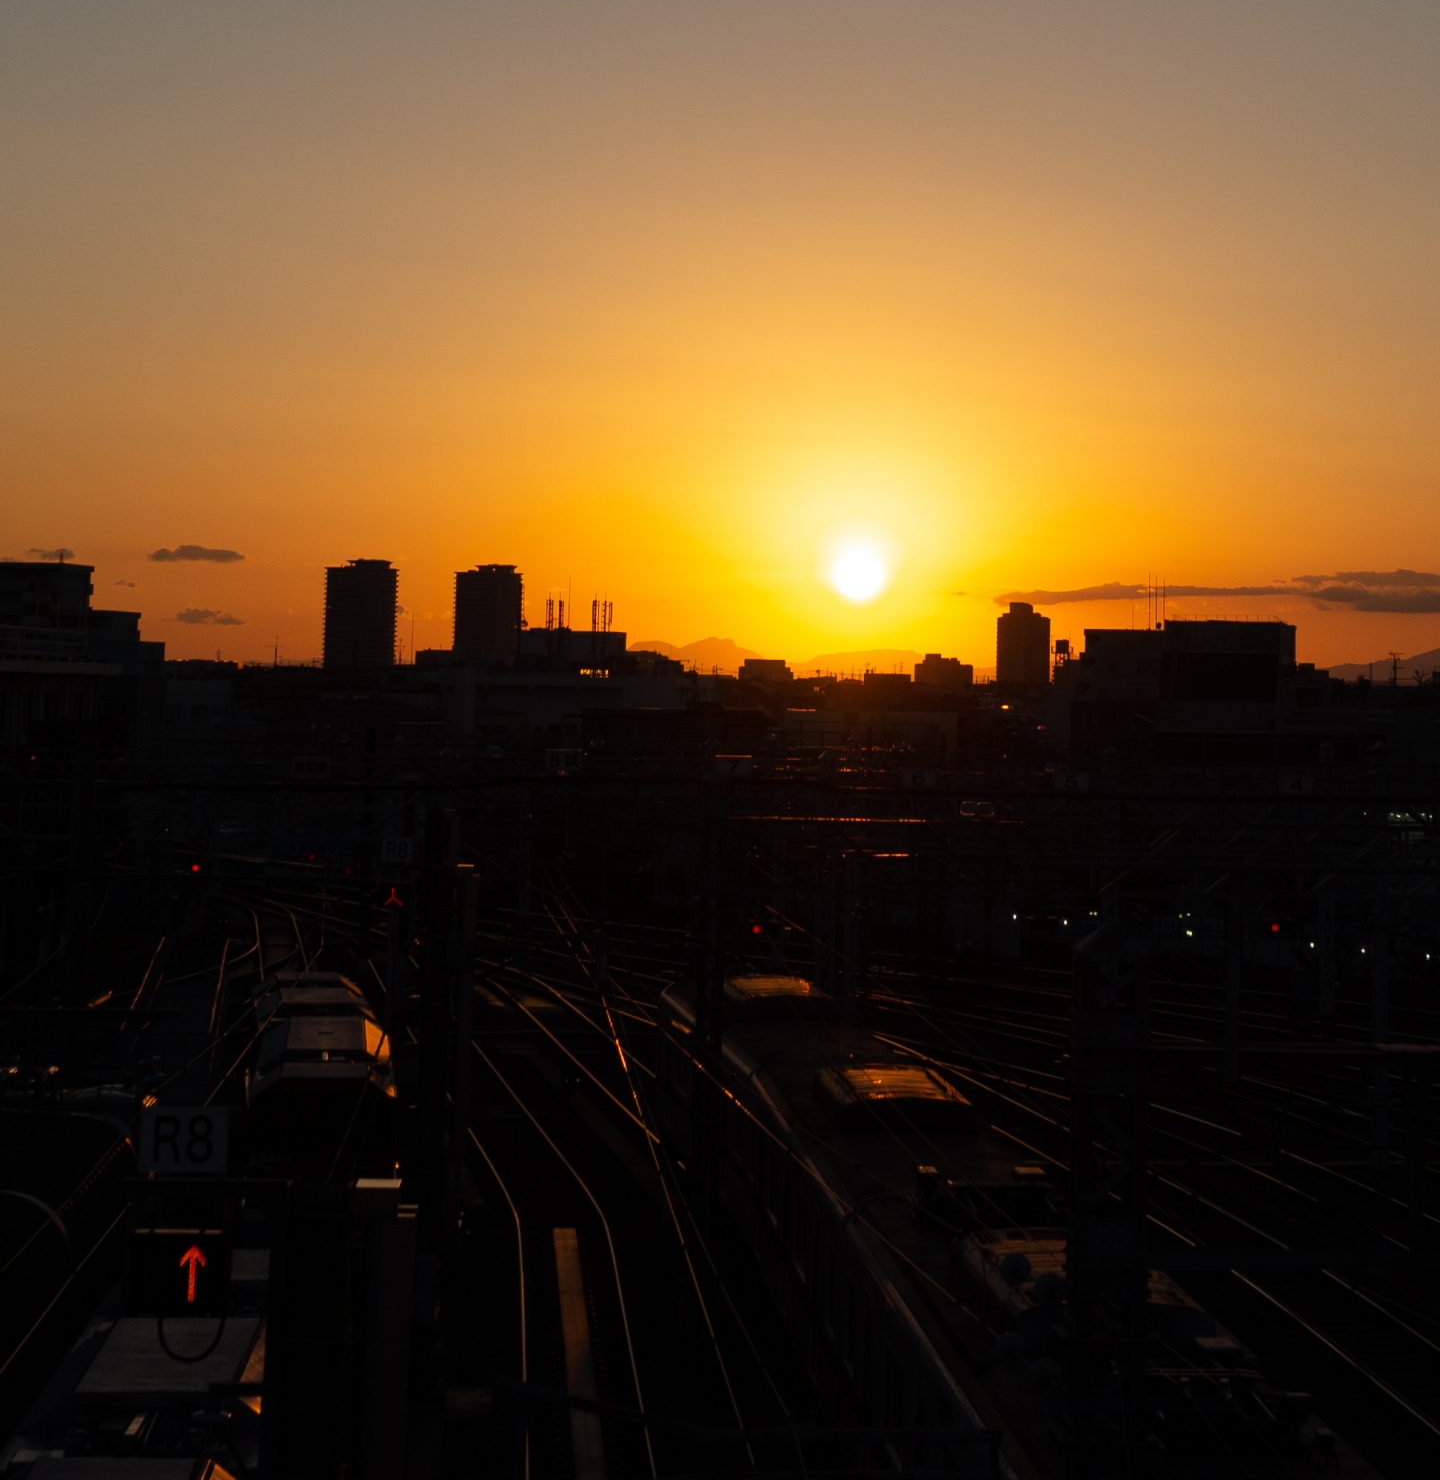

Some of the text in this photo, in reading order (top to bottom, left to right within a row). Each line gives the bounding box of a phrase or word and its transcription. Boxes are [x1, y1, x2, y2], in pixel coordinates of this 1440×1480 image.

[728, 759, 740, 773] 7
[912, 771, 925, 786] 6
[1065, 775, 1078, 789] 5
[1290, 778, 1303, 791] 4
[386, 841, 408, 859] R8
[153, 1115, 213, 1163] R8
